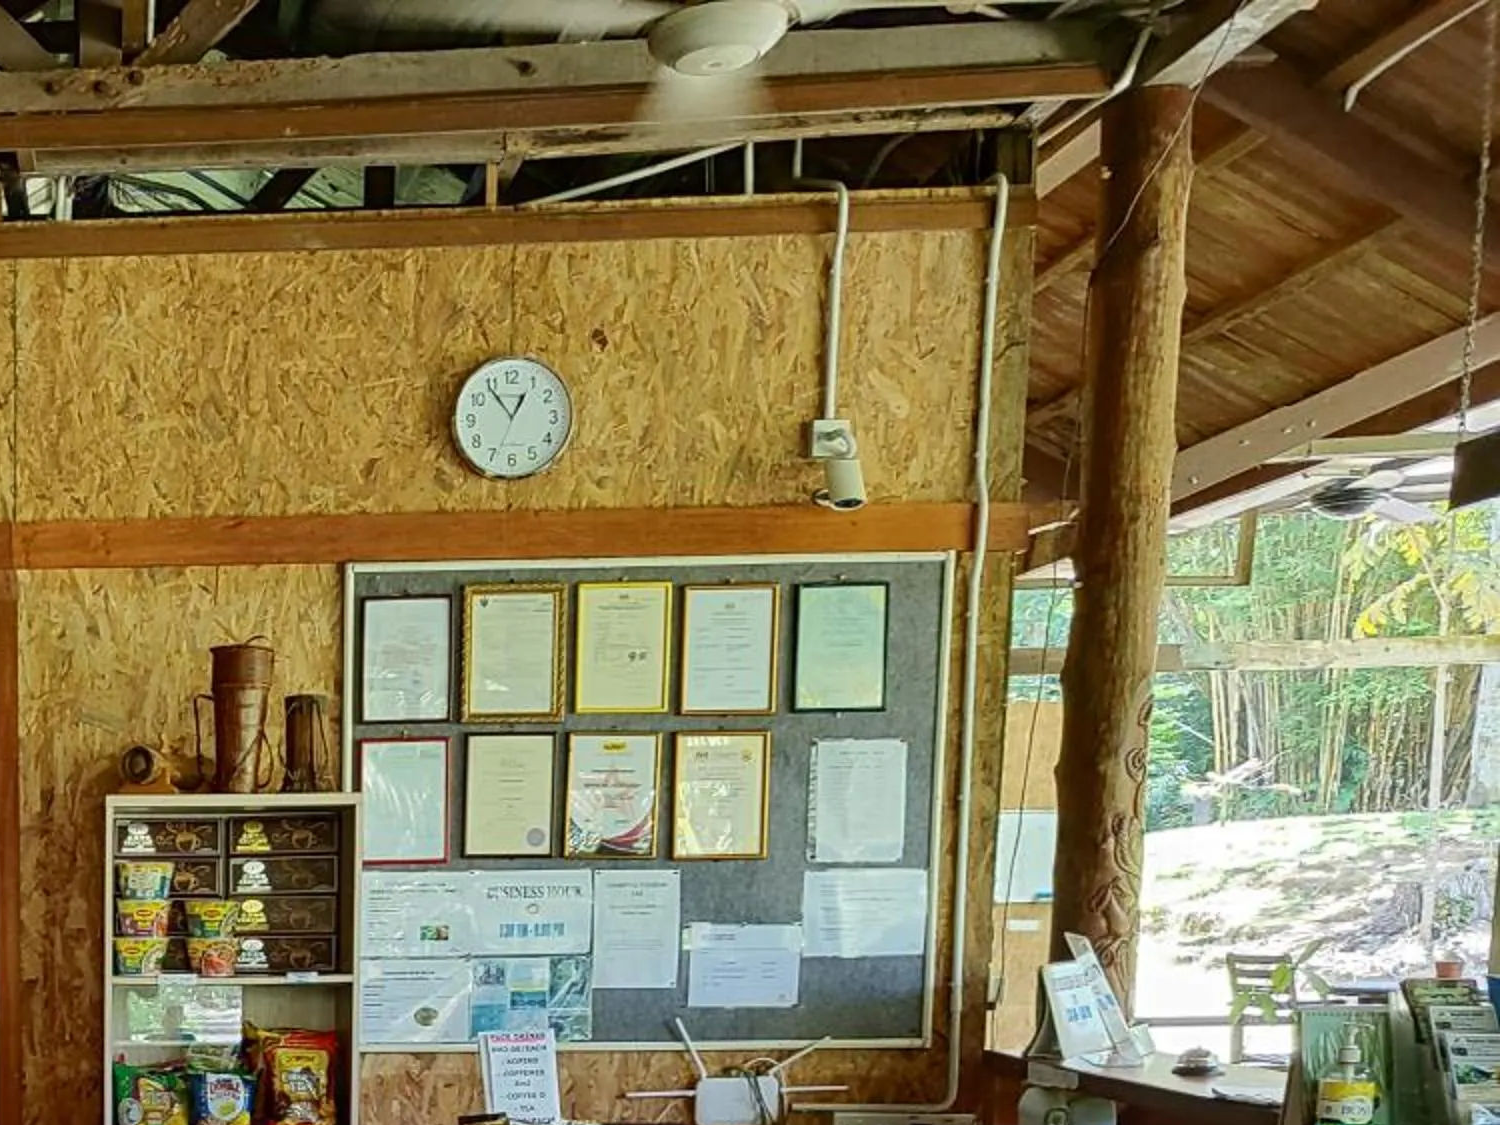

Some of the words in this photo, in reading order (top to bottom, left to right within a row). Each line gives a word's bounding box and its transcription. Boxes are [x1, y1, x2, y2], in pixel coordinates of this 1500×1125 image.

[486, 378, 497, 391] 11
[505, 370, 520, 385] 12
[530, 376, 537, 389] 1
[471, 392, 485, 407] 10
[543, 389, 553, 404] 2
[466, 413, 476, 428] 9
[548, 410, 559, 425] 3
[471, 434, 481, 448] 8
[542, 432, 552, 445] 4
[488, 448, 497, 462] 7
[507, 453, 517, 467] 6
[527, 446, 537, 460] 5
